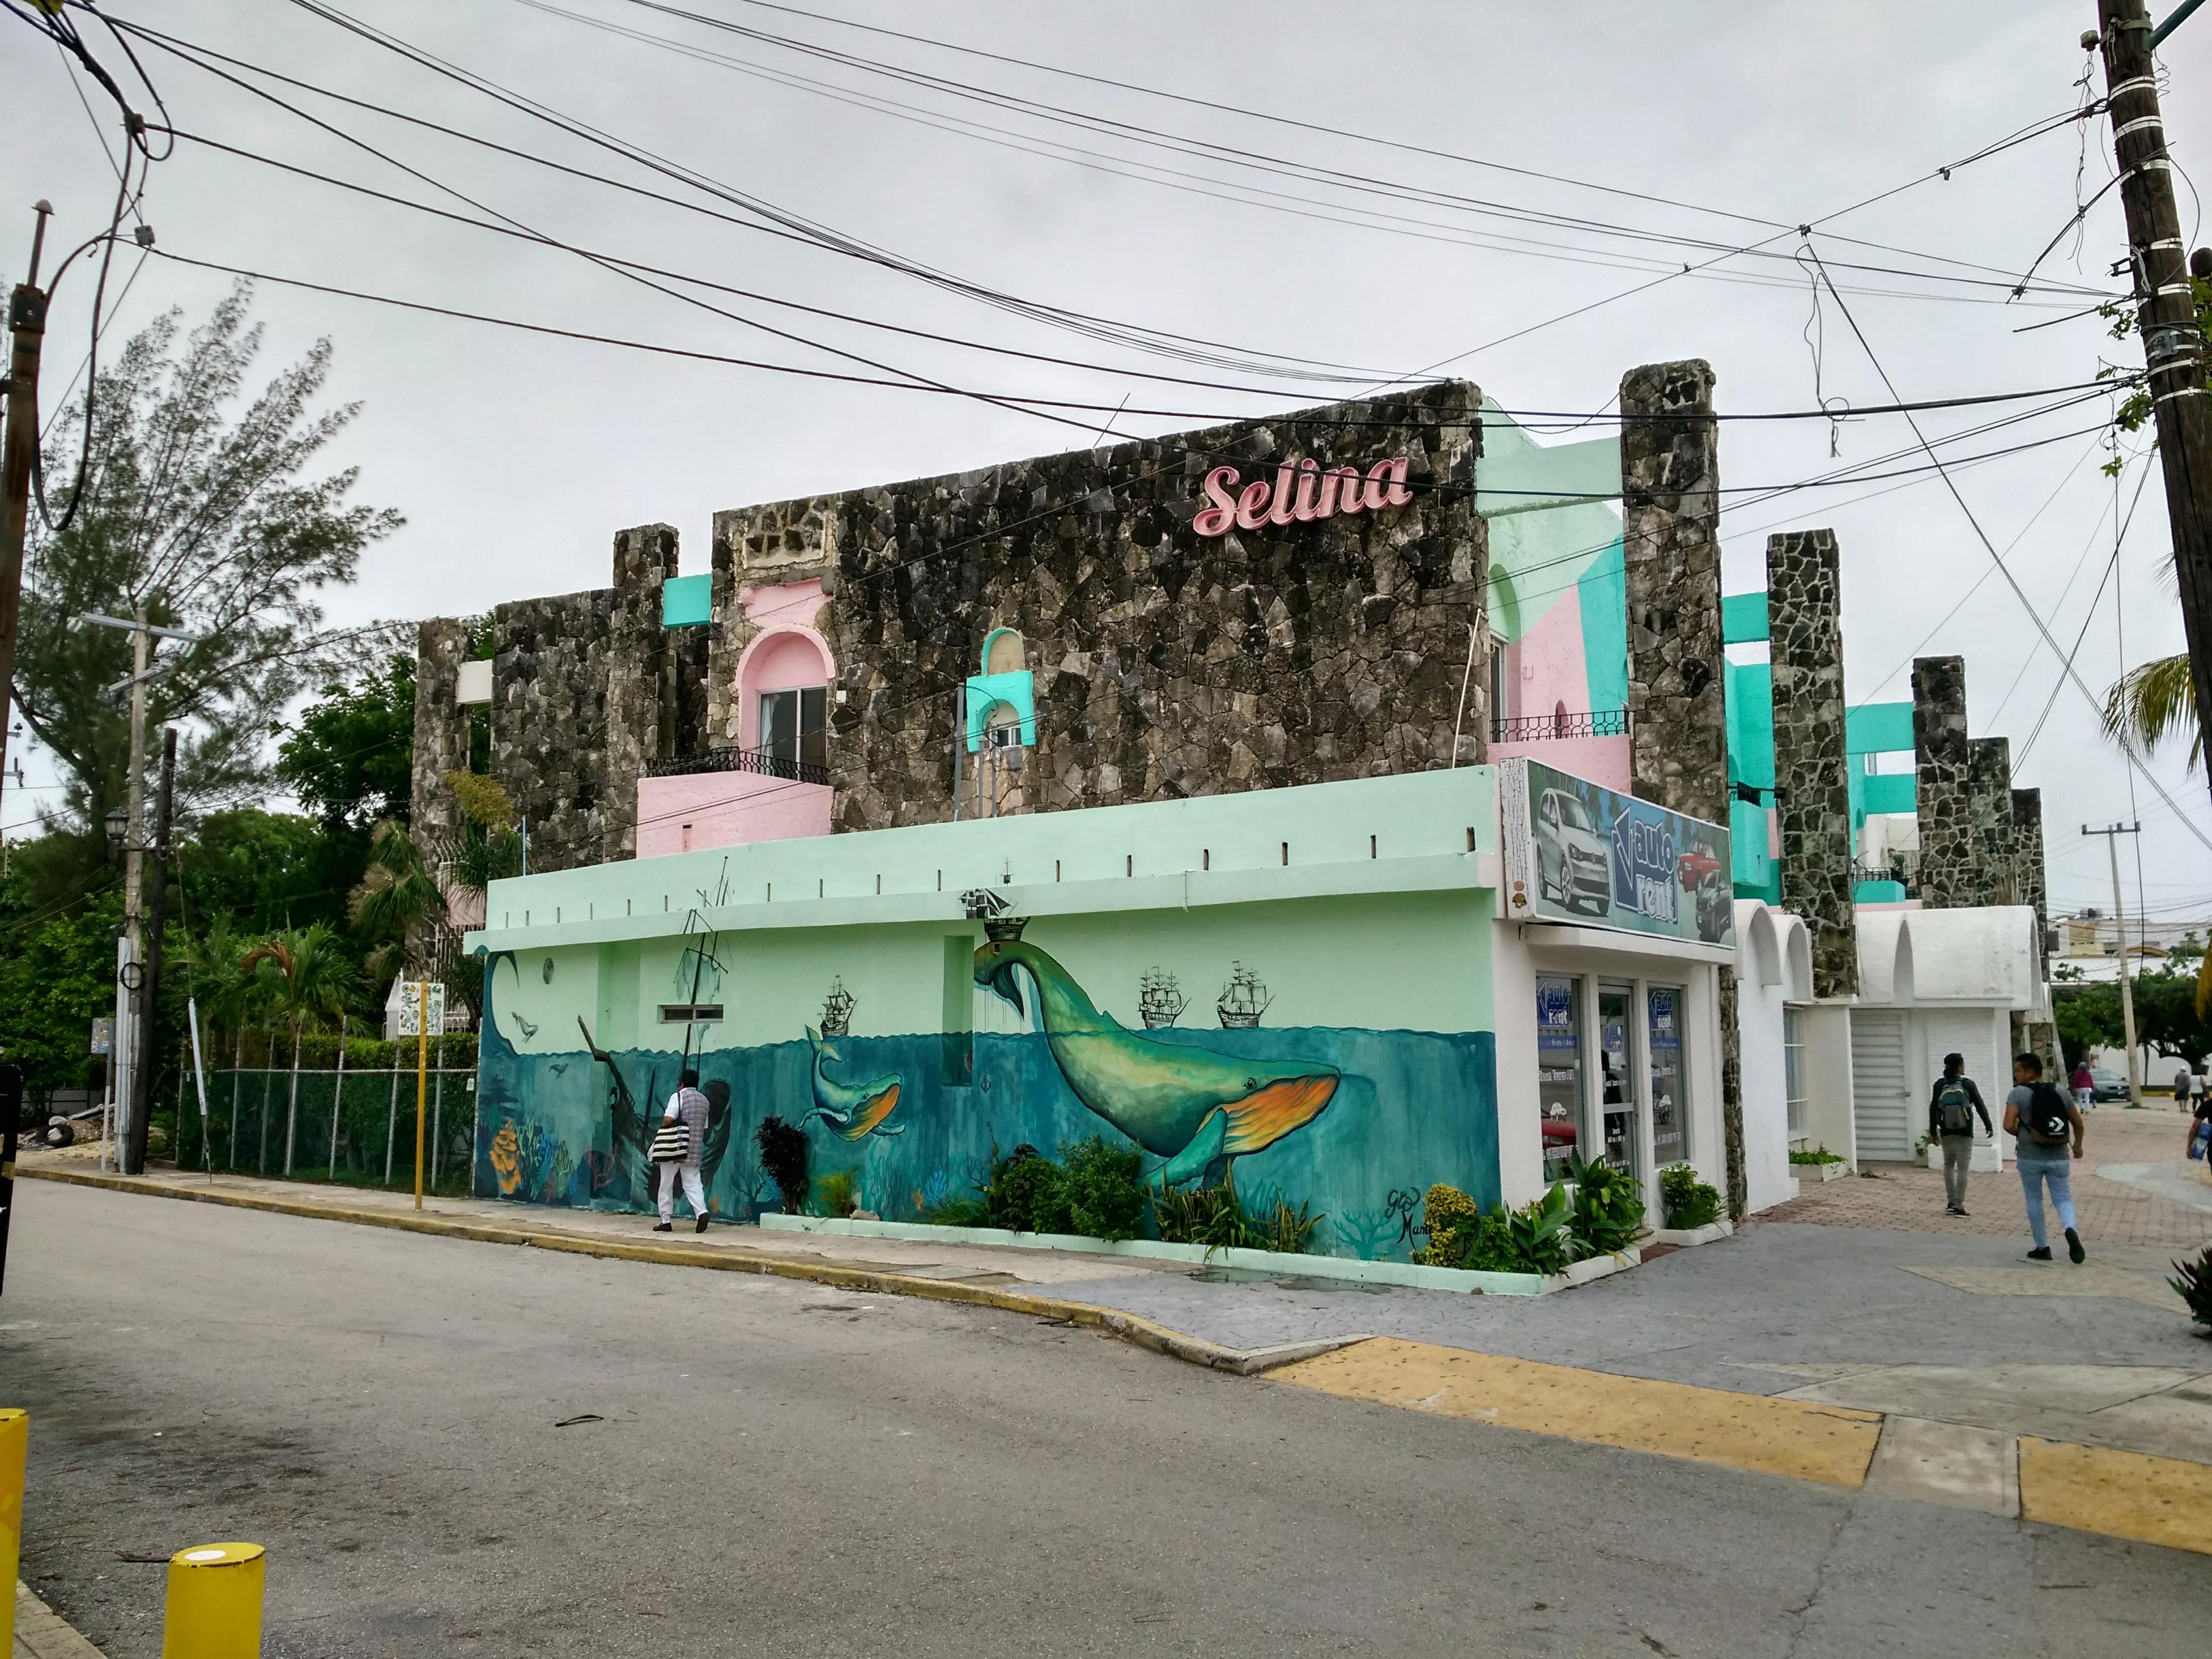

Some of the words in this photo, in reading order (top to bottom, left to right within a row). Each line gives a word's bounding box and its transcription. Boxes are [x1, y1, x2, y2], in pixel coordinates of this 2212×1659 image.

[1193, 456, 1414, 537] Selina
[1635, 874, 1675, 924] rent
[1548, 1006, 1569, 1026] rent
